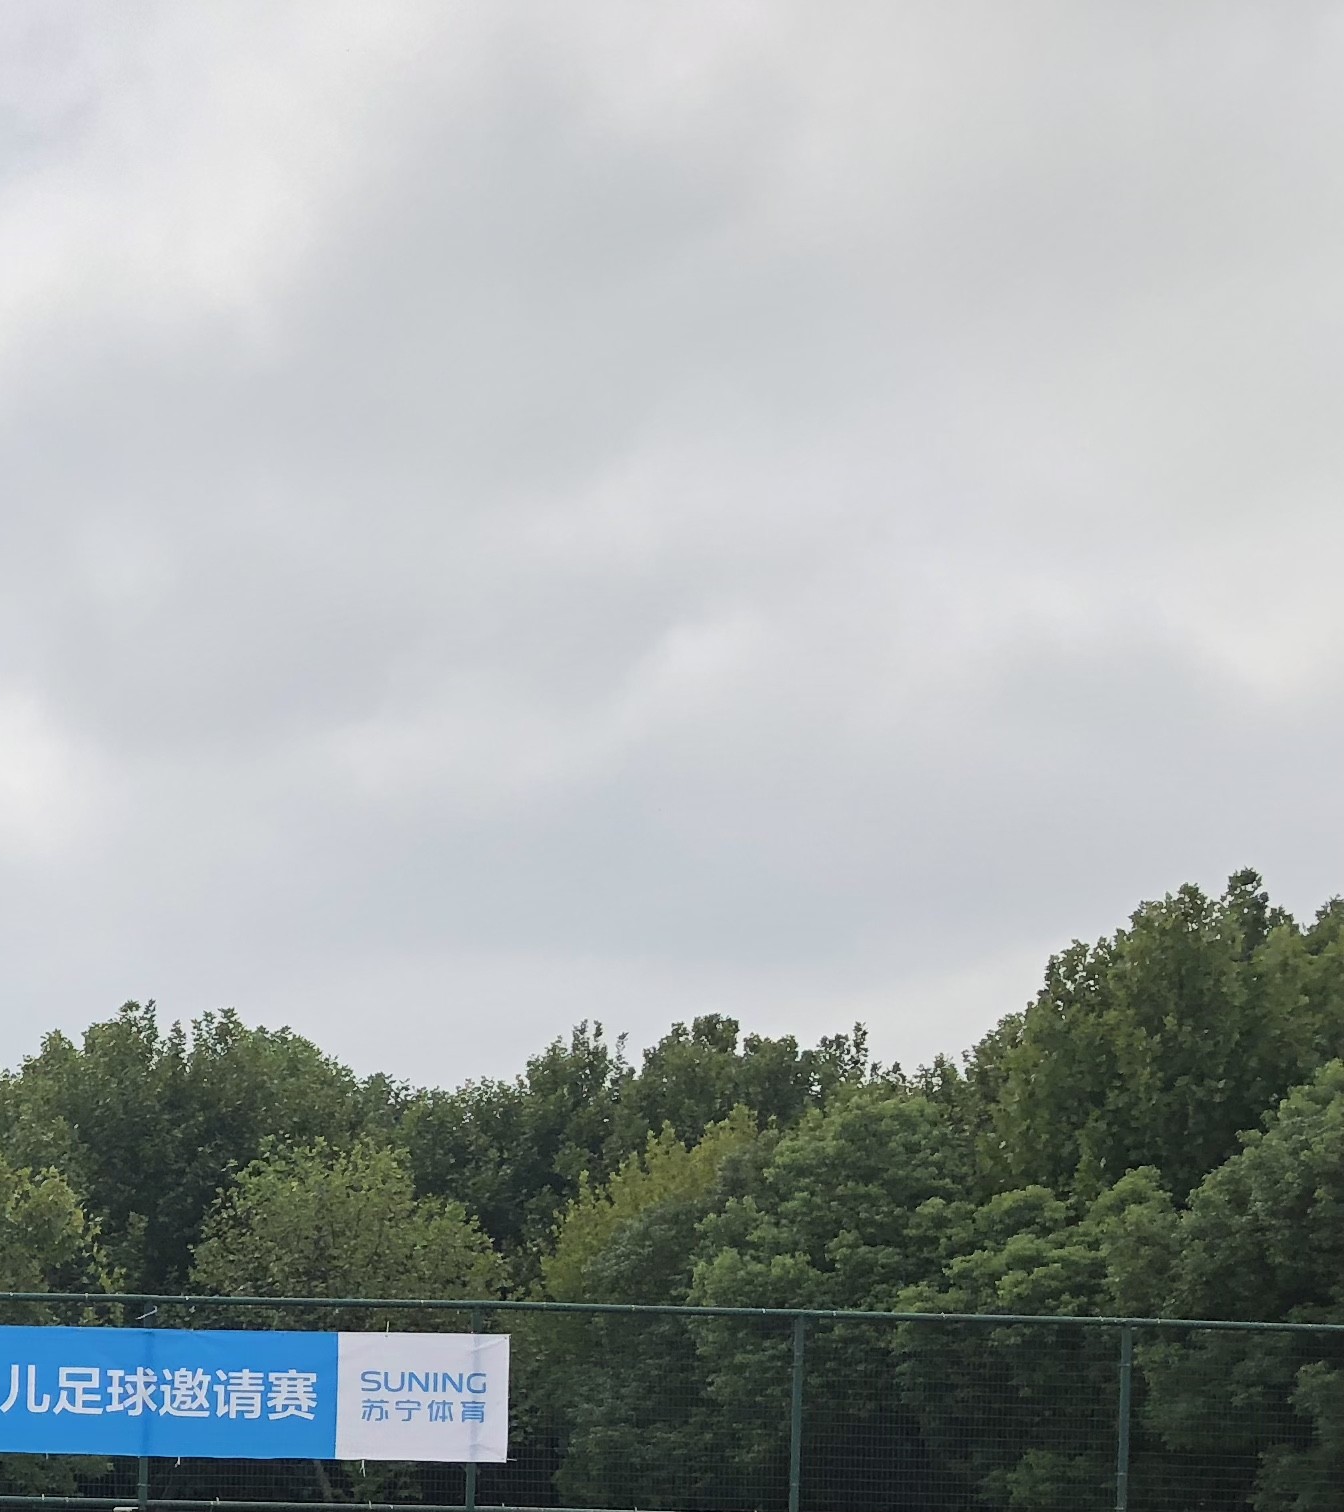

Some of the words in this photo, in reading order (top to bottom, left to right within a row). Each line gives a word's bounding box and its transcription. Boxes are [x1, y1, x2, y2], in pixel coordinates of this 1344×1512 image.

[360, 1369, 487, 1395] SUNING
[360, 1398, 486, 1424] 苏宁体育
